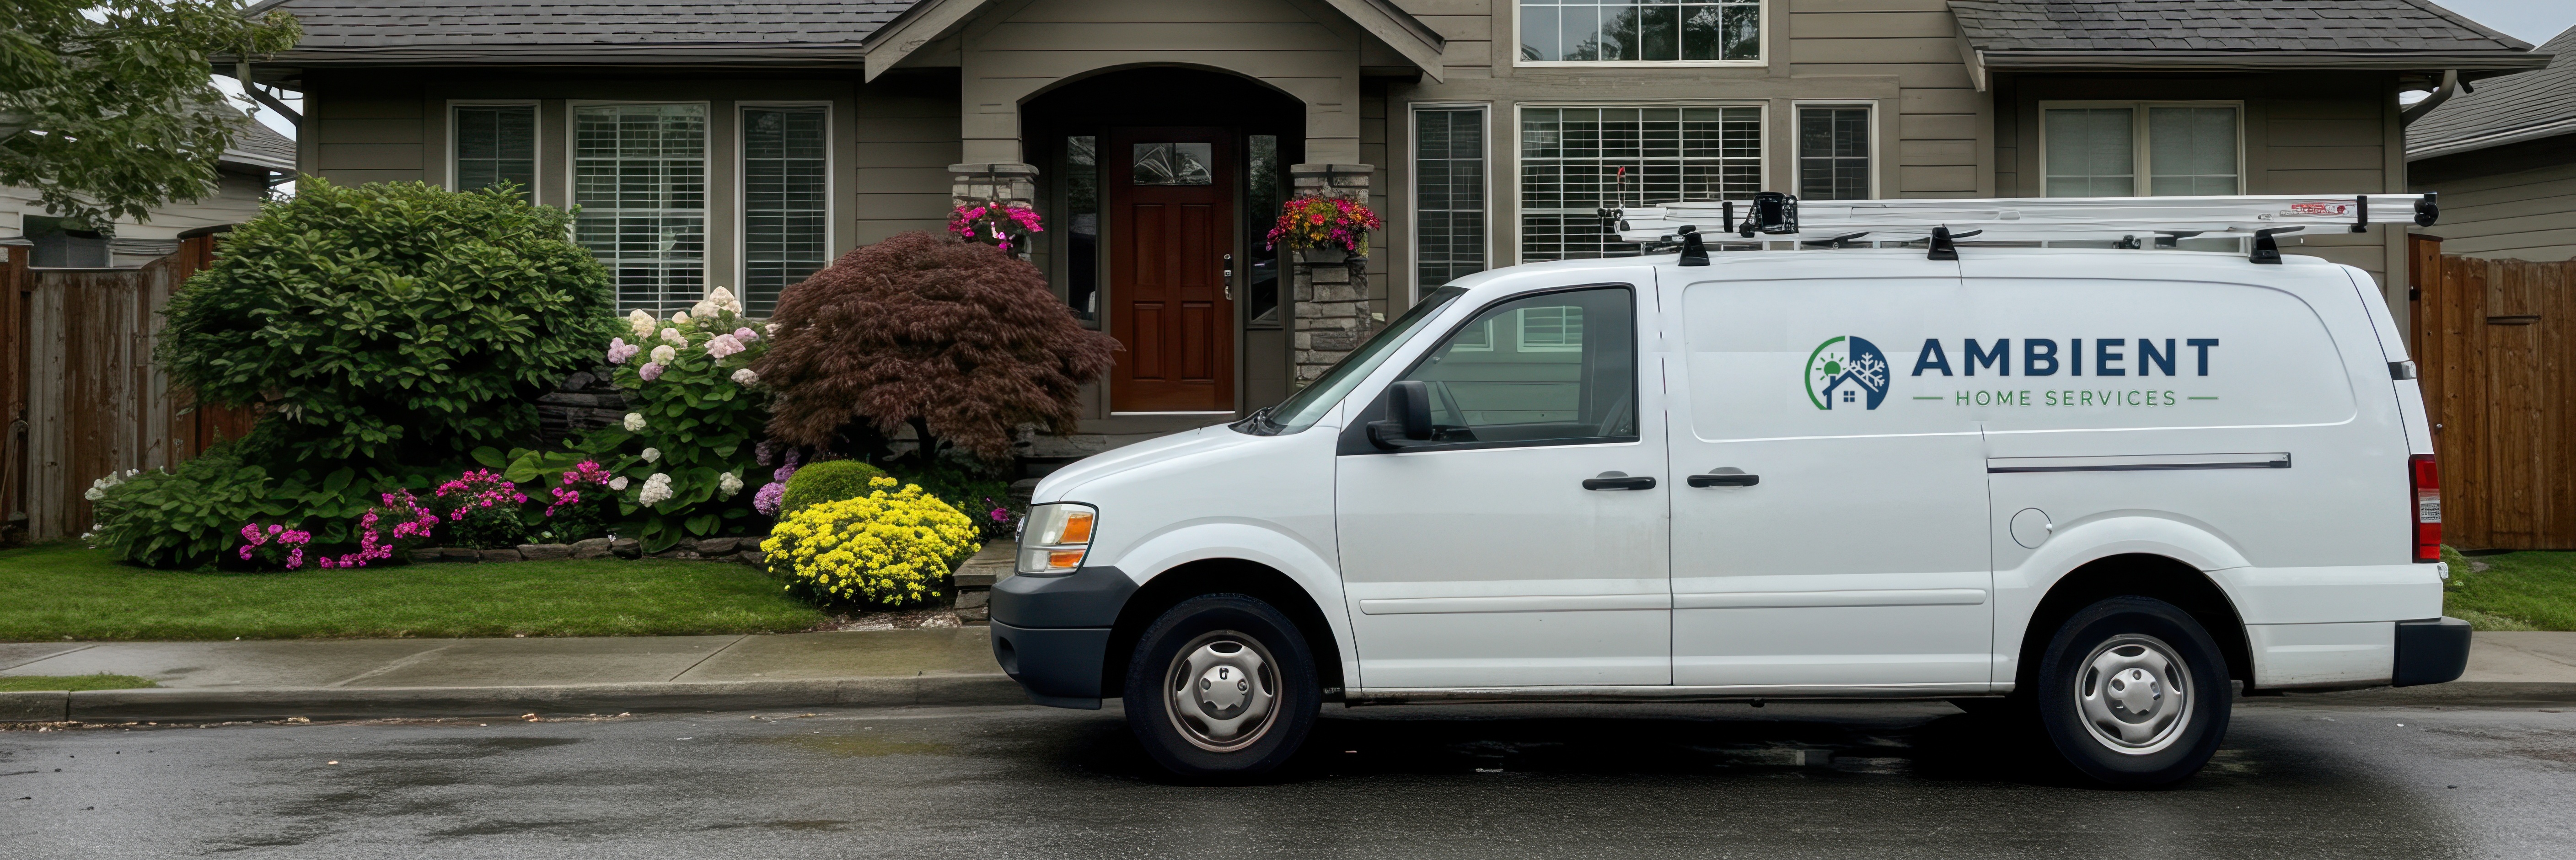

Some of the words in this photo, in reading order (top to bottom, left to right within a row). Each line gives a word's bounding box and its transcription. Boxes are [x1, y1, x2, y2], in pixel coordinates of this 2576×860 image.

[1911, 339, 2219, 376] AMBIENT
[1956, 390, 2031, 406] HOME
[2046, 390, 2176, 406] SERVICES
